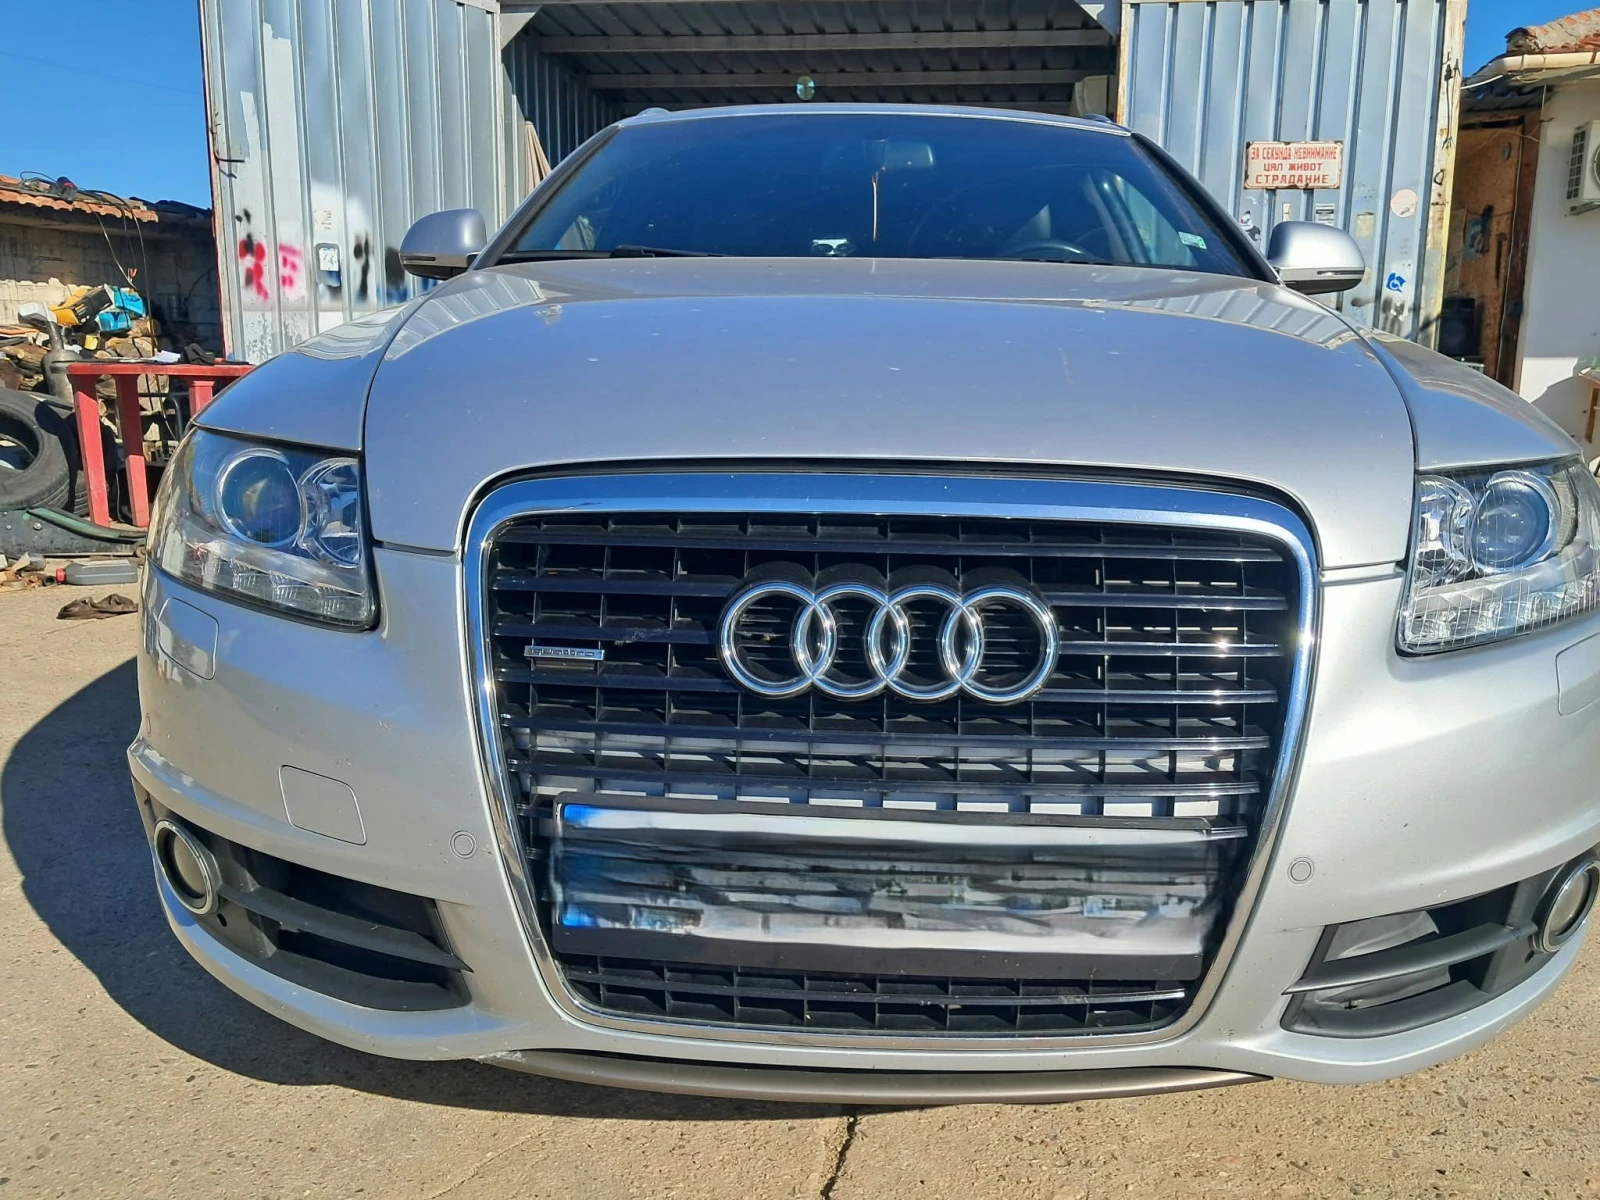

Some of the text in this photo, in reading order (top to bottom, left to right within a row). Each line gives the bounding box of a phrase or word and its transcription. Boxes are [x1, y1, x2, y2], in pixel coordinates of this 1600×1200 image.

[1251, 147, 1338, 160] ЗА СЕКУНДА НЕВНИМАНИЕ
[1263, 163, 1323, 172] ЦЯЛ ЖИВОТ
[1255, 174, 1329, 185] СТРАДАНИЕ
[531, 648, 595, 657] quattro
